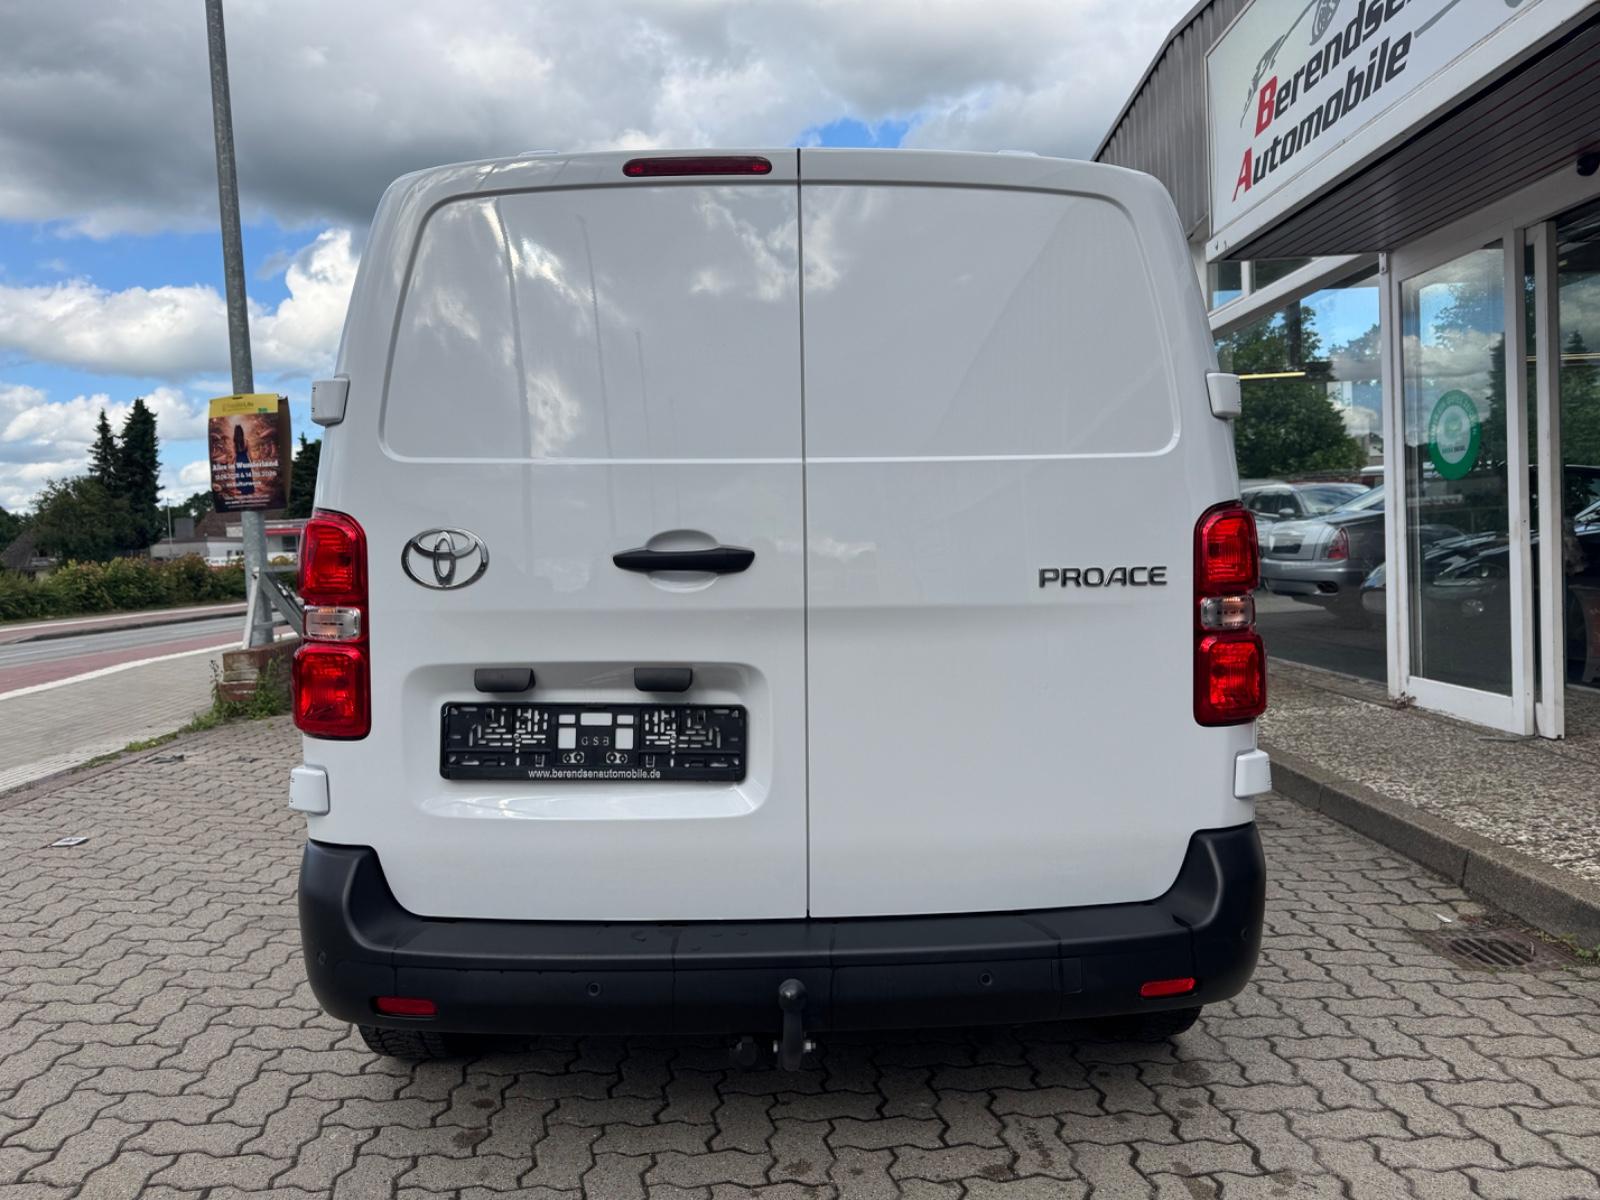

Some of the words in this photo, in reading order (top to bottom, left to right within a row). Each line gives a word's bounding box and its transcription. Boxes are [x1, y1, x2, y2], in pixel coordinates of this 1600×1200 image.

[1255, 0, 1411, 138] Berends
[1233, 31, 1412, 202] Automobile
[236, 460, 279, 469] Wunderland
[1039, 566, 1167, 588] PROACE
[528, 768, 661, 779] www.berendsenautomobile.de
